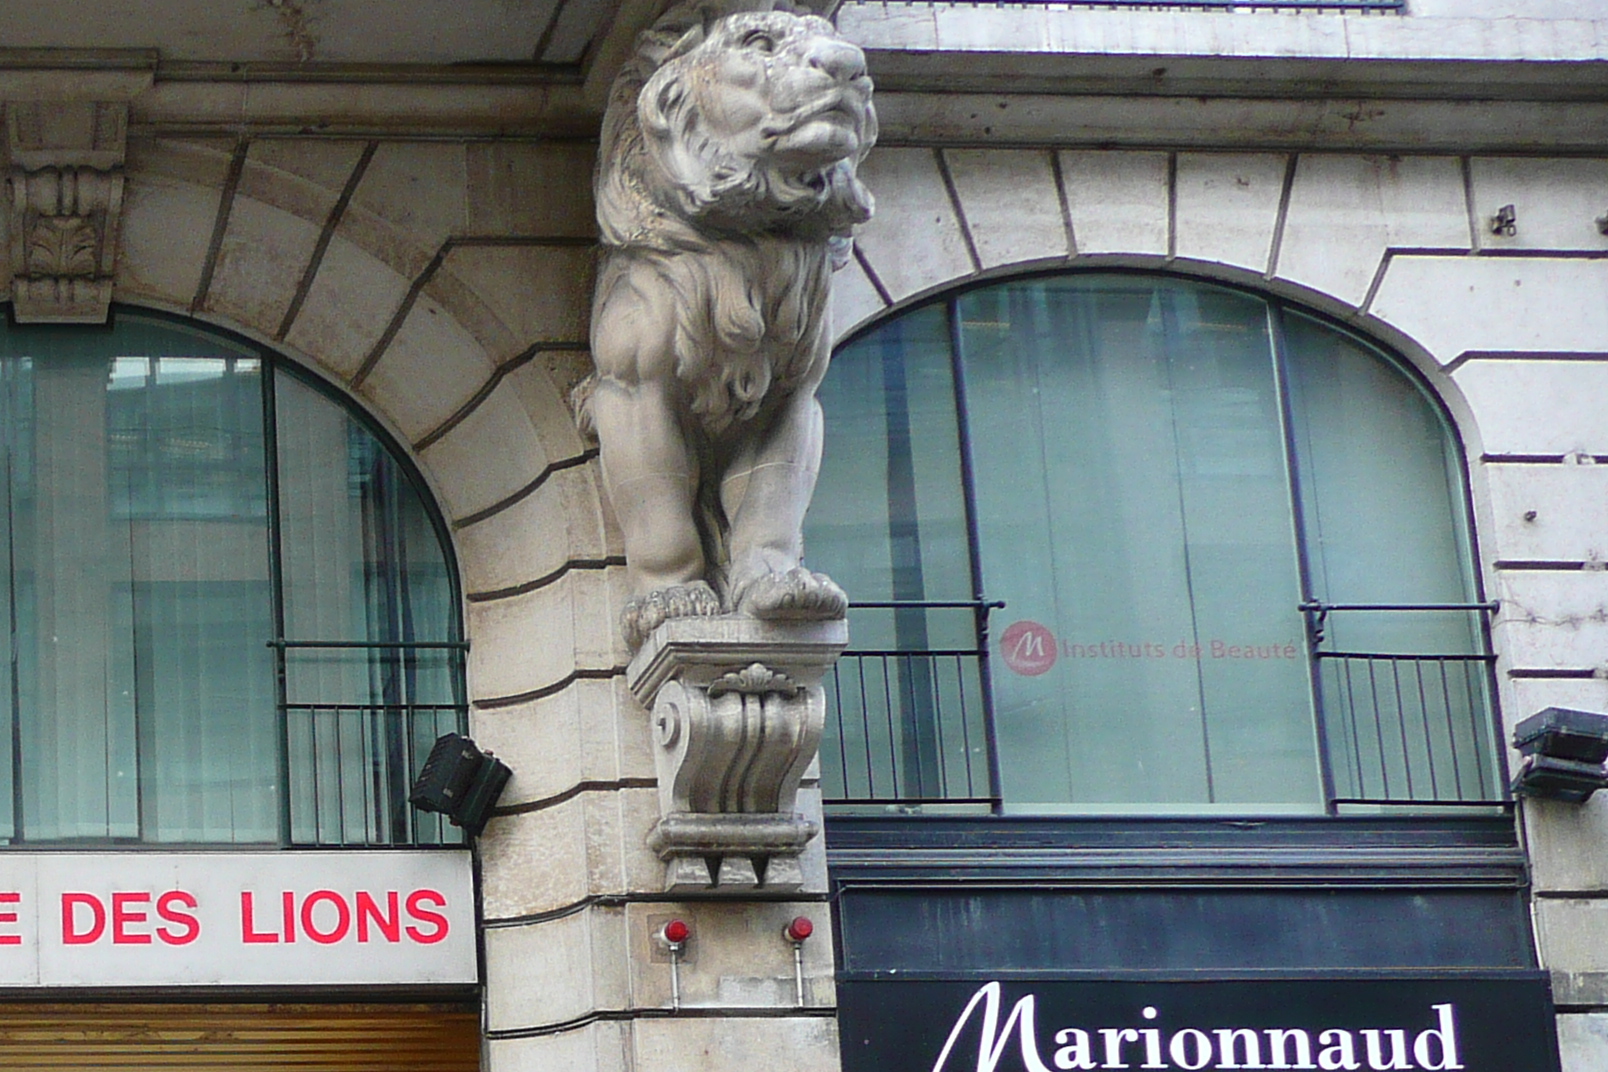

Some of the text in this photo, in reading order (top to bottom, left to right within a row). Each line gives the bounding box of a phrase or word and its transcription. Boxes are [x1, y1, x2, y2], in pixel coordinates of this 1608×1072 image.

[1063, 638, 1298, 660] Instituts de Beauté
[61, 890, 200, 946] DES
[240, 889, 450, 945] LIONS
